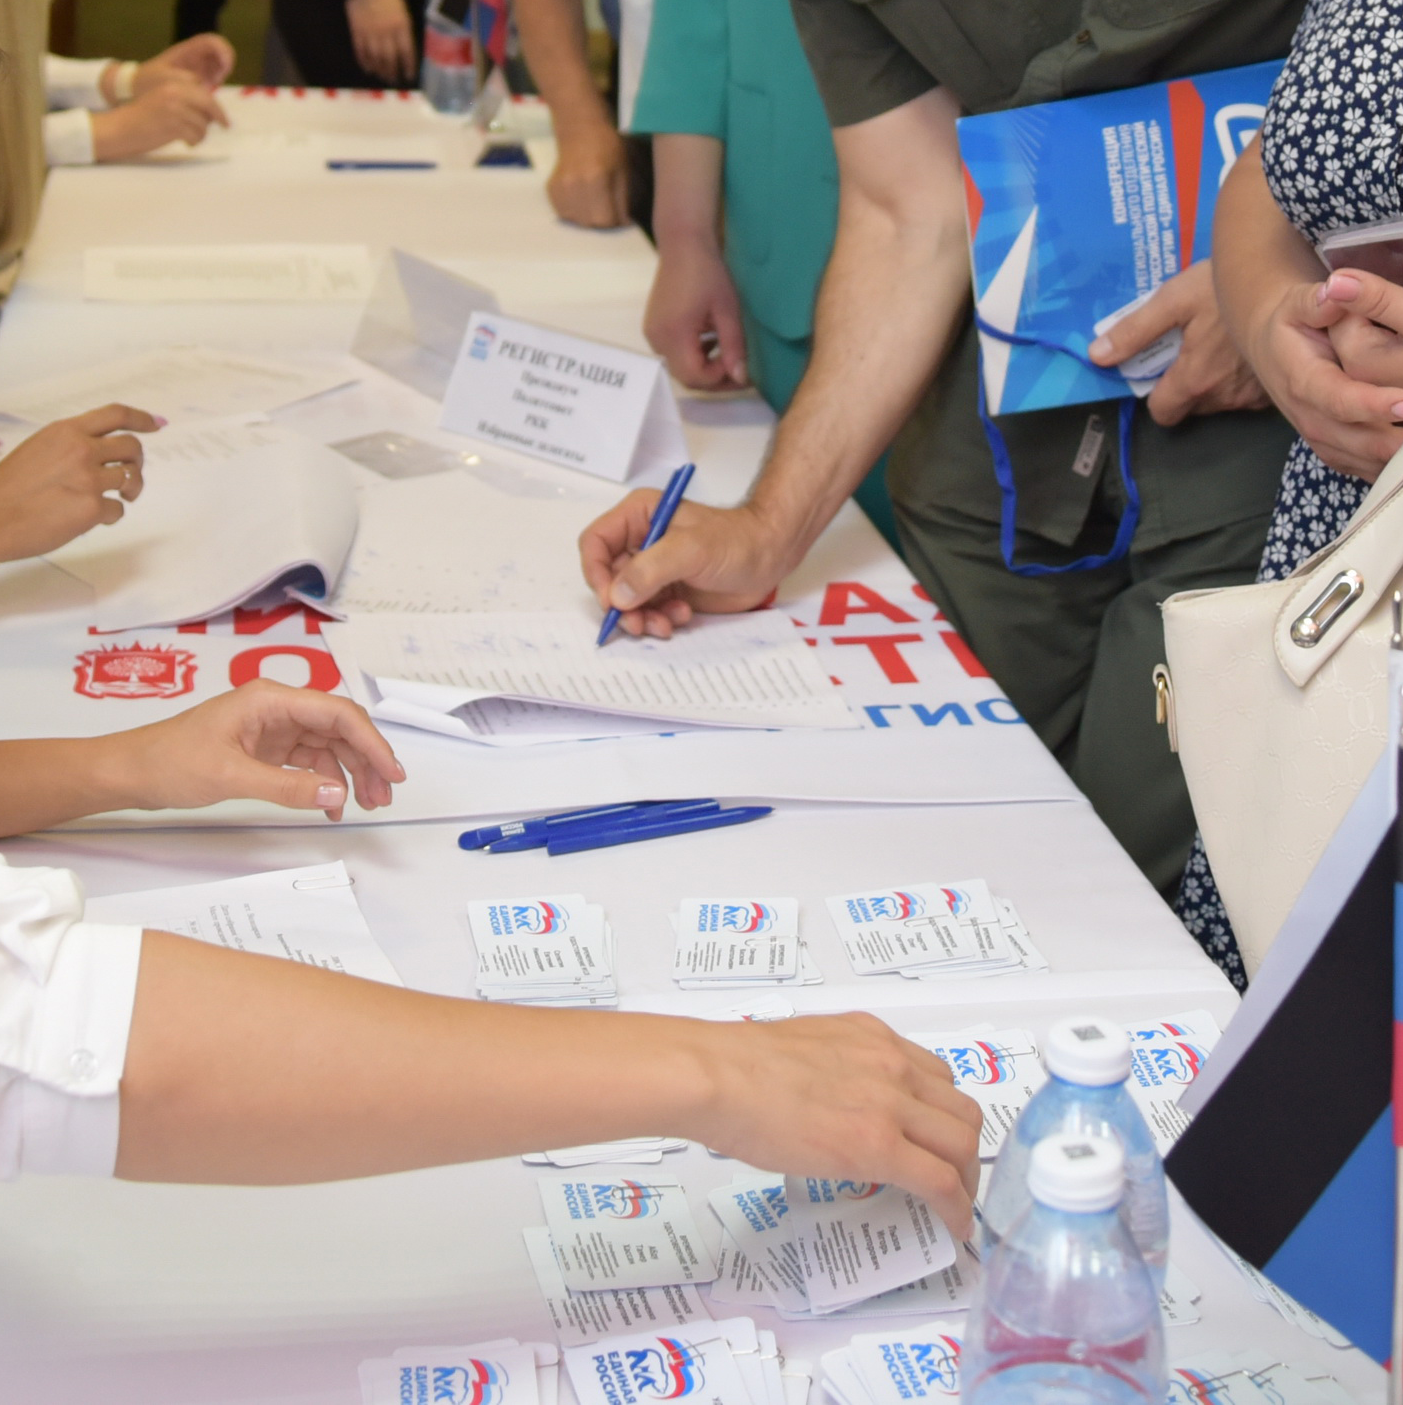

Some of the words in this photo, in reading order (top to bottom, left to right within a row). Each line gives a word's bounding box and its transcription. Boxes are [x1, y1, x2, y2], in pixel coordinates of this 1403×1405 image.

[1103, 126, 1127, 224] КОНФЕРЕНЦИЯ
[1119, 123, 1138, 192] ОТДЕЛЕНИЯ
[1134, 121, 1154, 211] ПОЛИТИЧЕСКОЙ
[1129, 195, 1147, 287] РЕГИОНАЛЬНОГО
[1145, 213, 1161, 287] РОССИЙСКОЙ
[1161, 229, 1175, 274] ПАРТИИ
[499, 340, 627, 388] РЕГИСТРАЦИЯ
[488, 906, 502, 935] РОССИЯ
[499, 905, 513, 934] ЕДИНАЯ
[698, 904, 708, 931] РОССИЯ
[709, 904, 719, 931] ЕДИНАЯ
[844, 899, 863, 924] РОССИЯ
[855, 897, 874, 922] ЕДИНАЯ
[1136, 1047, 1162, 1087] ЕДИНАЯ
[562, 1183, 582, 1219] РОССИЯ
[576, 1183, 595, 1219] ЕДИНАЯ
[804, 1176, 823, 1204] СИЯ
[819, 1177, 835, 1203] НАЯ
[732, 1192, 766, 1234] РОССИЯ
[745, 1188, 779, 1231] ЕДИНАЯ
[919, 1203, 938, 1245] ВРЕМЕННОЕ
[635, 1244, 649, 1263] Тамер
[662, 1221, 686, 1264] УДОСТОВЕРЕНИЕ
[679, 1235, 699, 1265] ВРЕМЕННОЕ
[860, 1222, 882, 1271] Викторович
[875, 1230, 891, 1255] Игорь
[887, 1224, 904, 1252] Лызов
[624, 1292, 643, 1319] Альбина
[672, 1285, 693, 1314] РЕМЕННОЕ
[400, 1367, 412, 1405] РОССИ
[416, 1366, 427, 1405] ЕДИНА
[607, 1351, 638, 1405] ЕДИНАЯ
[878, 1344, 914, 1399] РОССИЯ
[892, 1342, 927, 1397] ЕДИНАЯ
